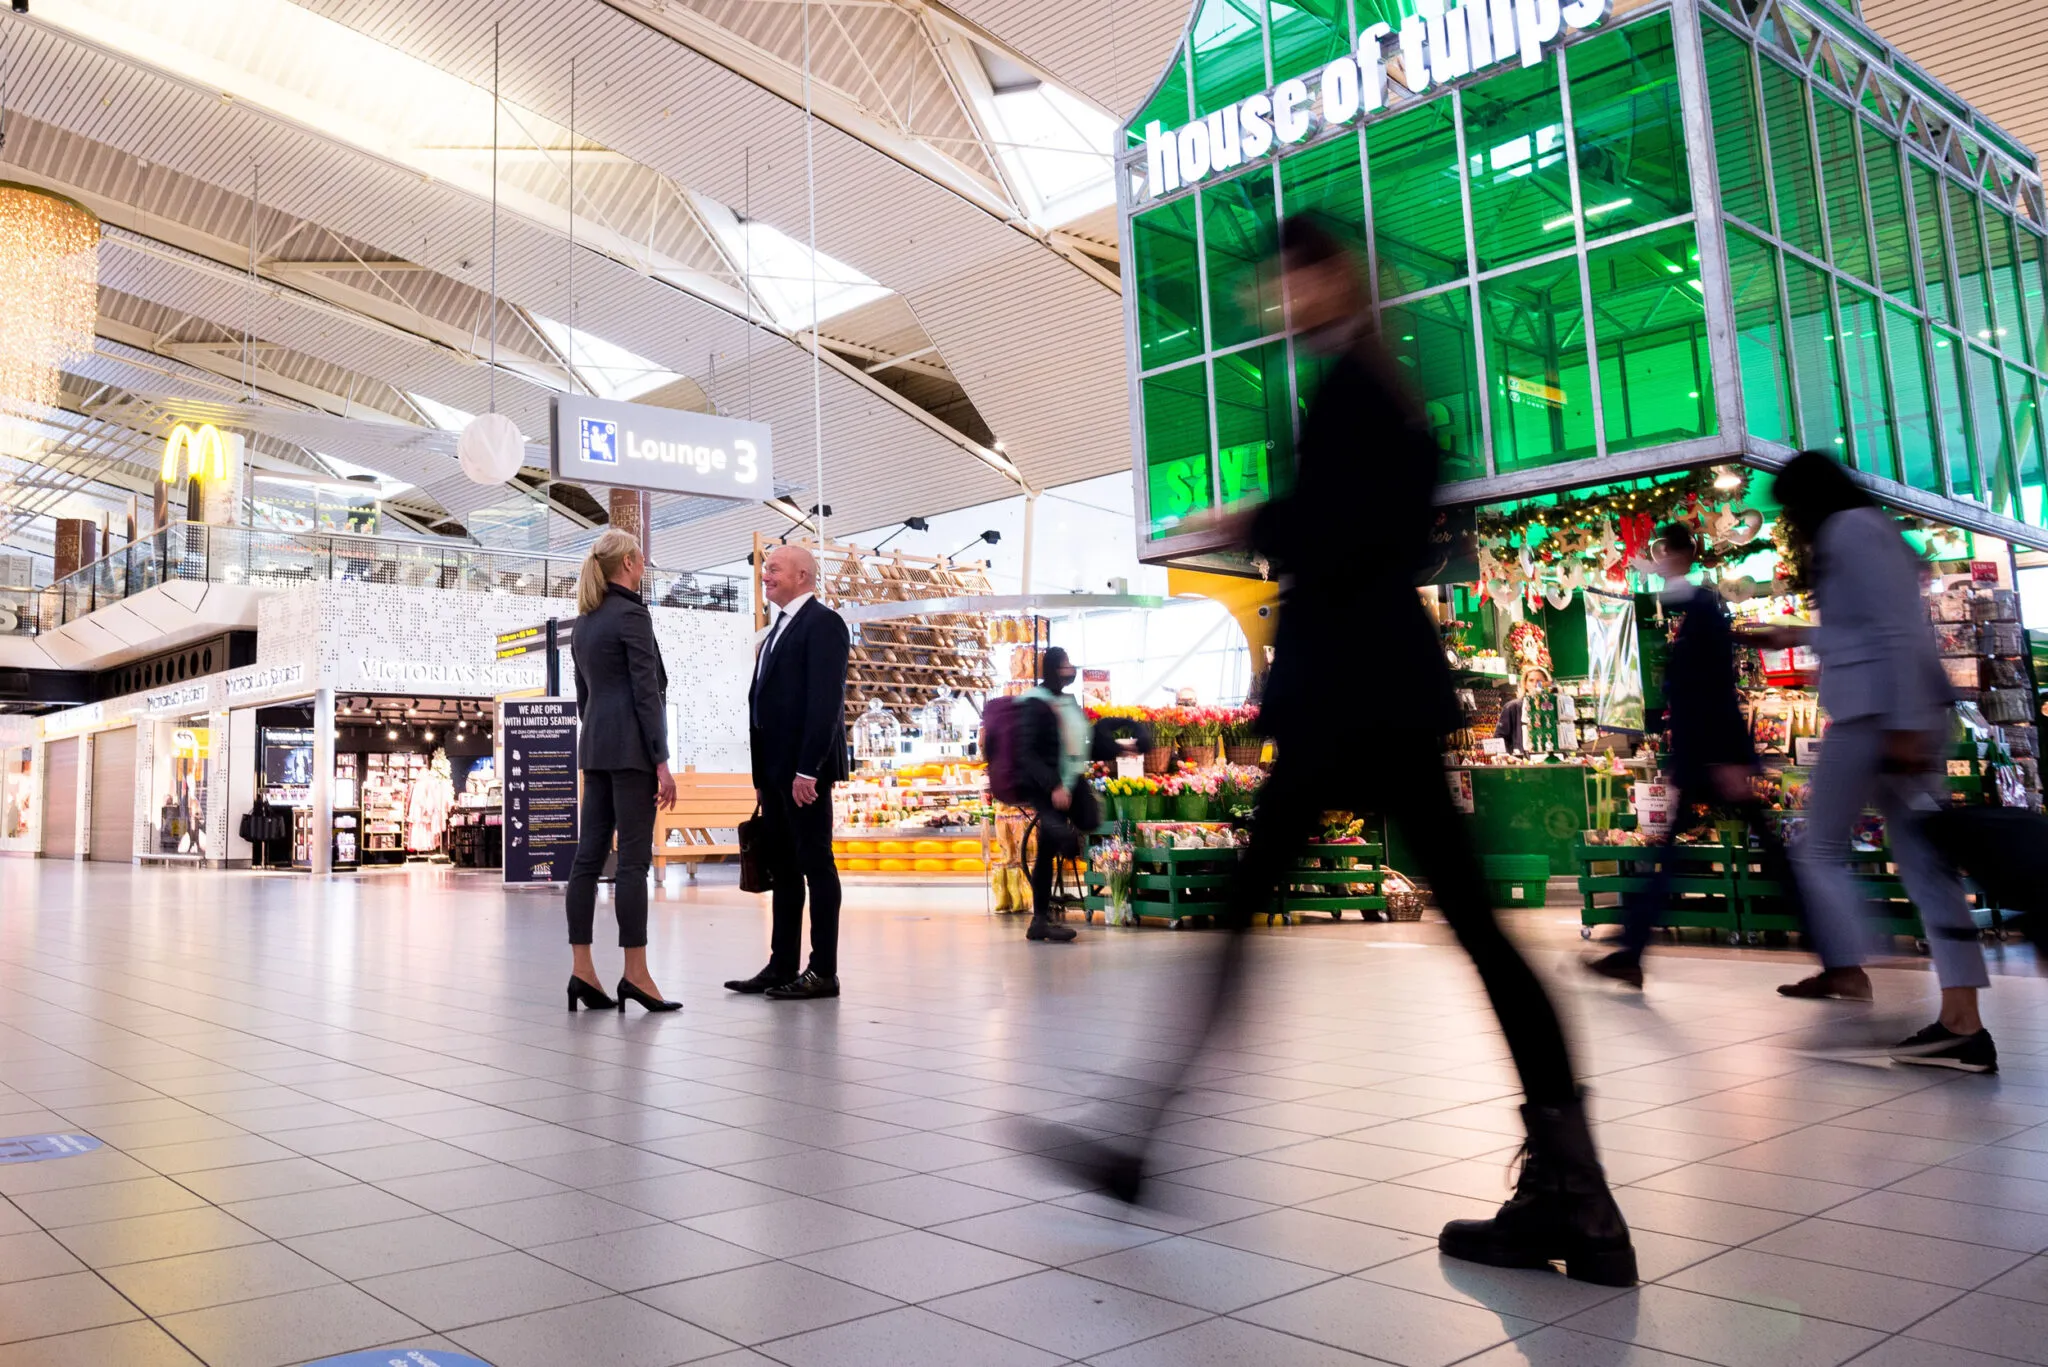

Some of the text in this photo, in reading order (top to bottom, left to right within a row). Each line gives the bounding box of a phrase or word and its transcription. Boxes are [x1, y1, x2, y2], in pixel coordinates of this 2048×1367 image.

[1144, 78, 1310, 199] house
[1320, 22, 1390, 125] of
[625, 430, 758, 484] Lounge 3
[361, 660, 546, 687] VICTORIA'S SECRE
[504, 716, 577, 726] WITH LIMITED SEATING
[518, 704, 562, 714] WE ARE OPEN
